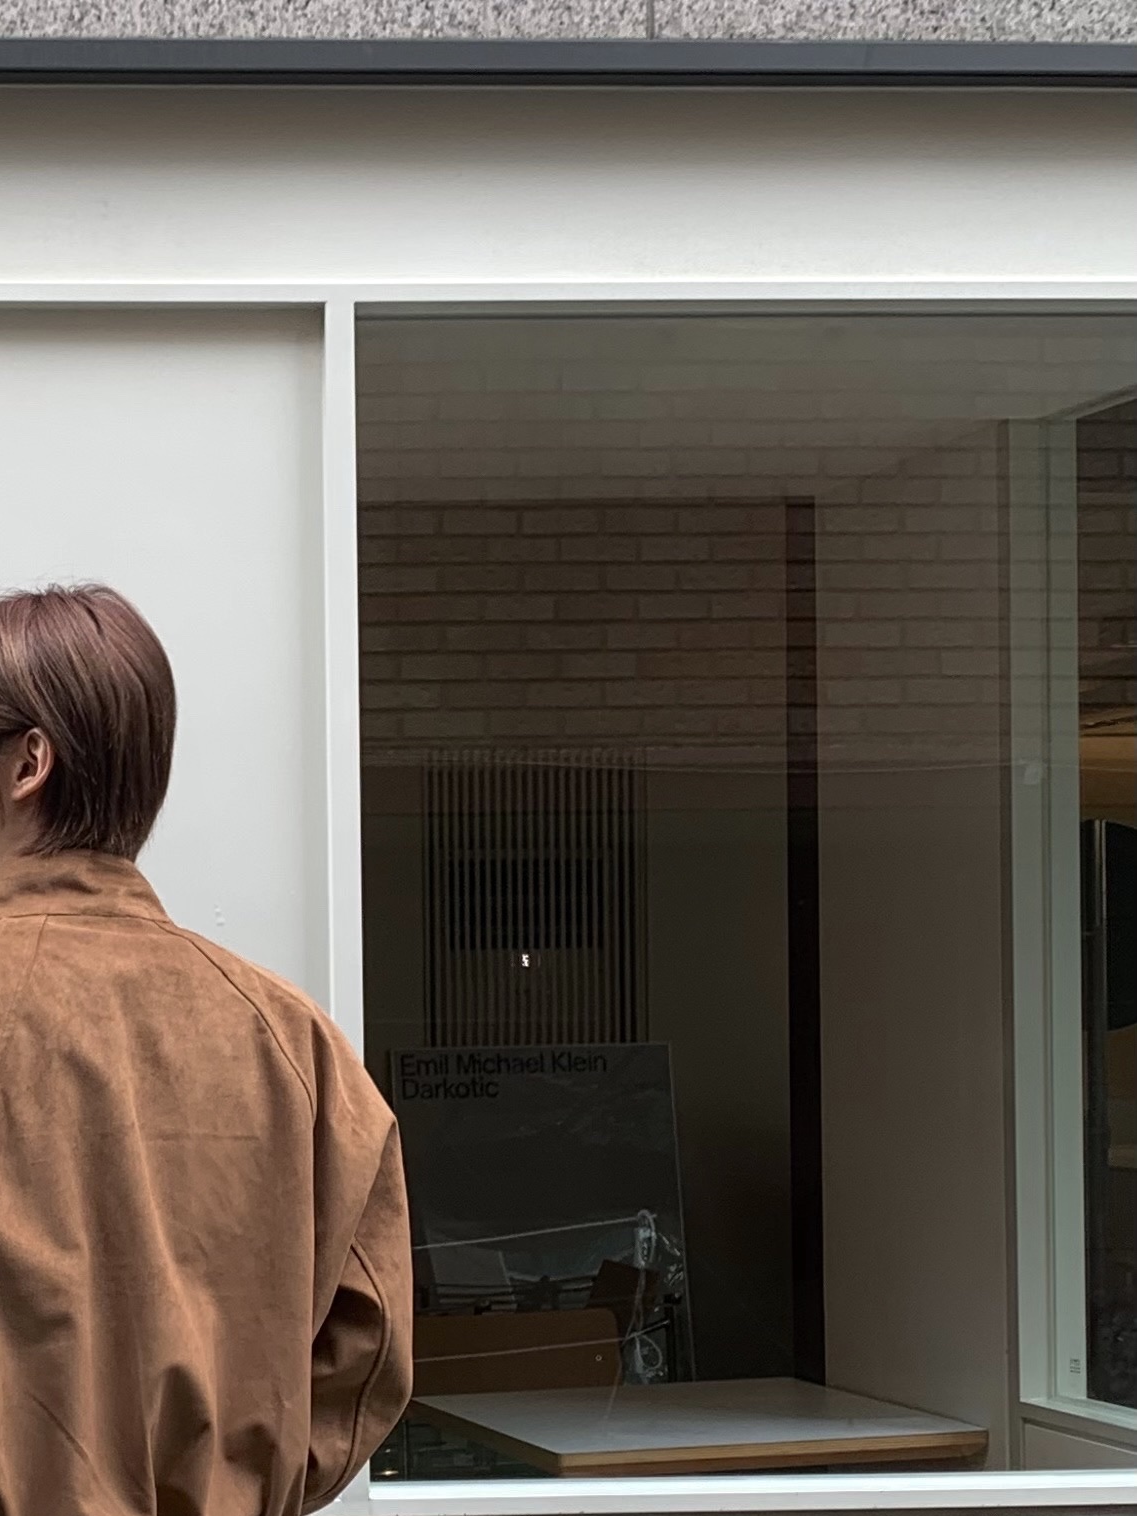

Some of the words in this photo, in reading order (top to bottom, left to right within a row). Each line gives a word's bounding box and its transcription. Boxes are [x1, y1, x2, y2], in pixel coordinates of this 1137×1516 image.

[400, 1054, 449, 1077] Emil
[457, 1052, 545, 1075] Michael
[551, 1051, 608, 1073] Klein
[401, 1077, 500, 1100] Darkotic
